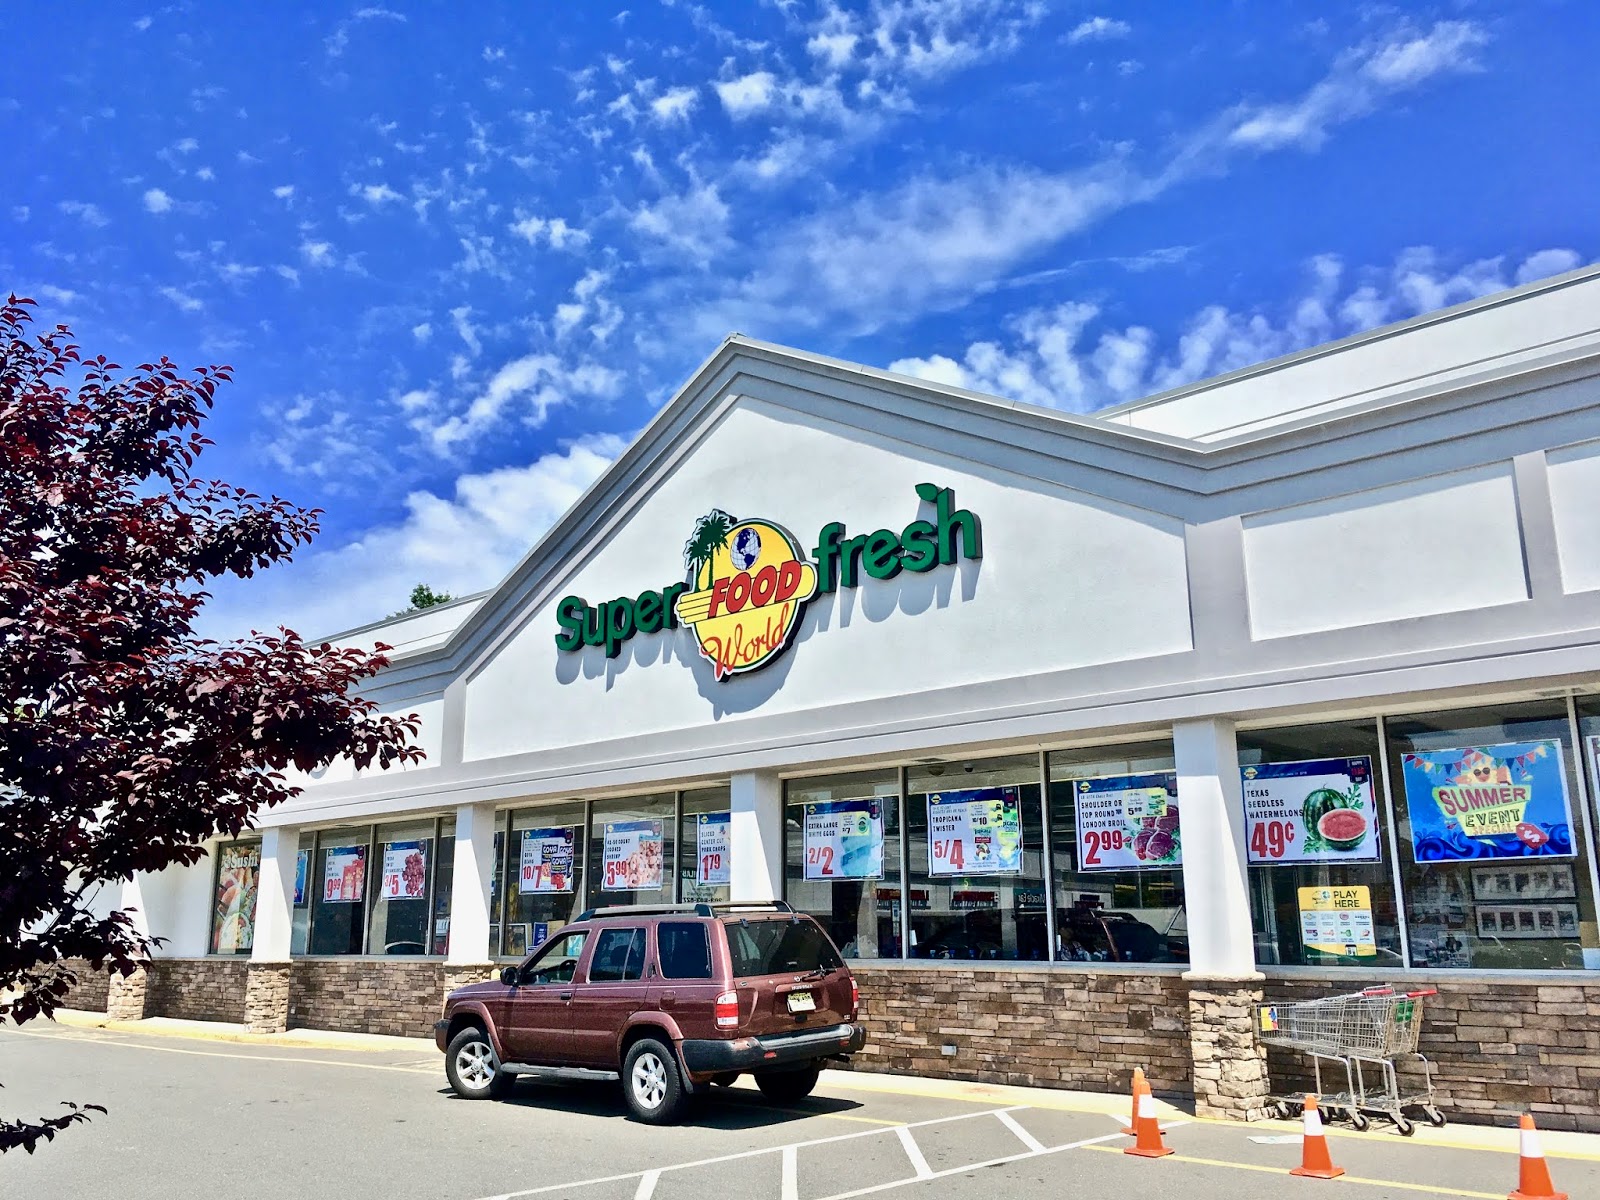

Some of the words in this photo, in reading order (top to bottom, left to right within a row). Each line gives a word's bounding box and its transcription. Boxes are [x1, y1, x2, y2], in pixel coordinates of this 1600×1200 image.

[555, 582, 688, 658] Super
[812, 483, 982, 593] fresh
[708, 560, 802, 618] FOOD
[700, 603, 789, 680] World
[1247, 789, 1269, 798] TEXAS
[1439, 788, 1526, 815] SUMMER
[1081, 800, 1112, 809] SHOULDER
[1248, 799, 1284, 808] SEEDLESS
[933, 815, 962, 823] TROPICANA
[1082, 811, 1092, 819] TOP
[1094, 810, 1115, 818] ROUND
[1249, 809, 1304, 819] WATERMELONS
[1466, 809, 1520, 827] EVENT
[1082, 821, 1106, 829] LONDON
[1108, 819, 1126, 827] BROIL
[1084, 830, 1123, 864] 299
[1251, 821, 1294, 857] 49¢
[542, 846, 558, 854] GOYA
[934, 839, 965, 869] 5/4
[231, 852, 258, 869] Sushi
[808, 846, 834, 875] 2/2
[523, 865, 543, 888] 10/7
[606, 861, 627, 886] 599
[384, 874, 400, 895] 3/5
[1333, 890, 1358, 899] PLAY
[1334, 900, 1360, 908] HERE
